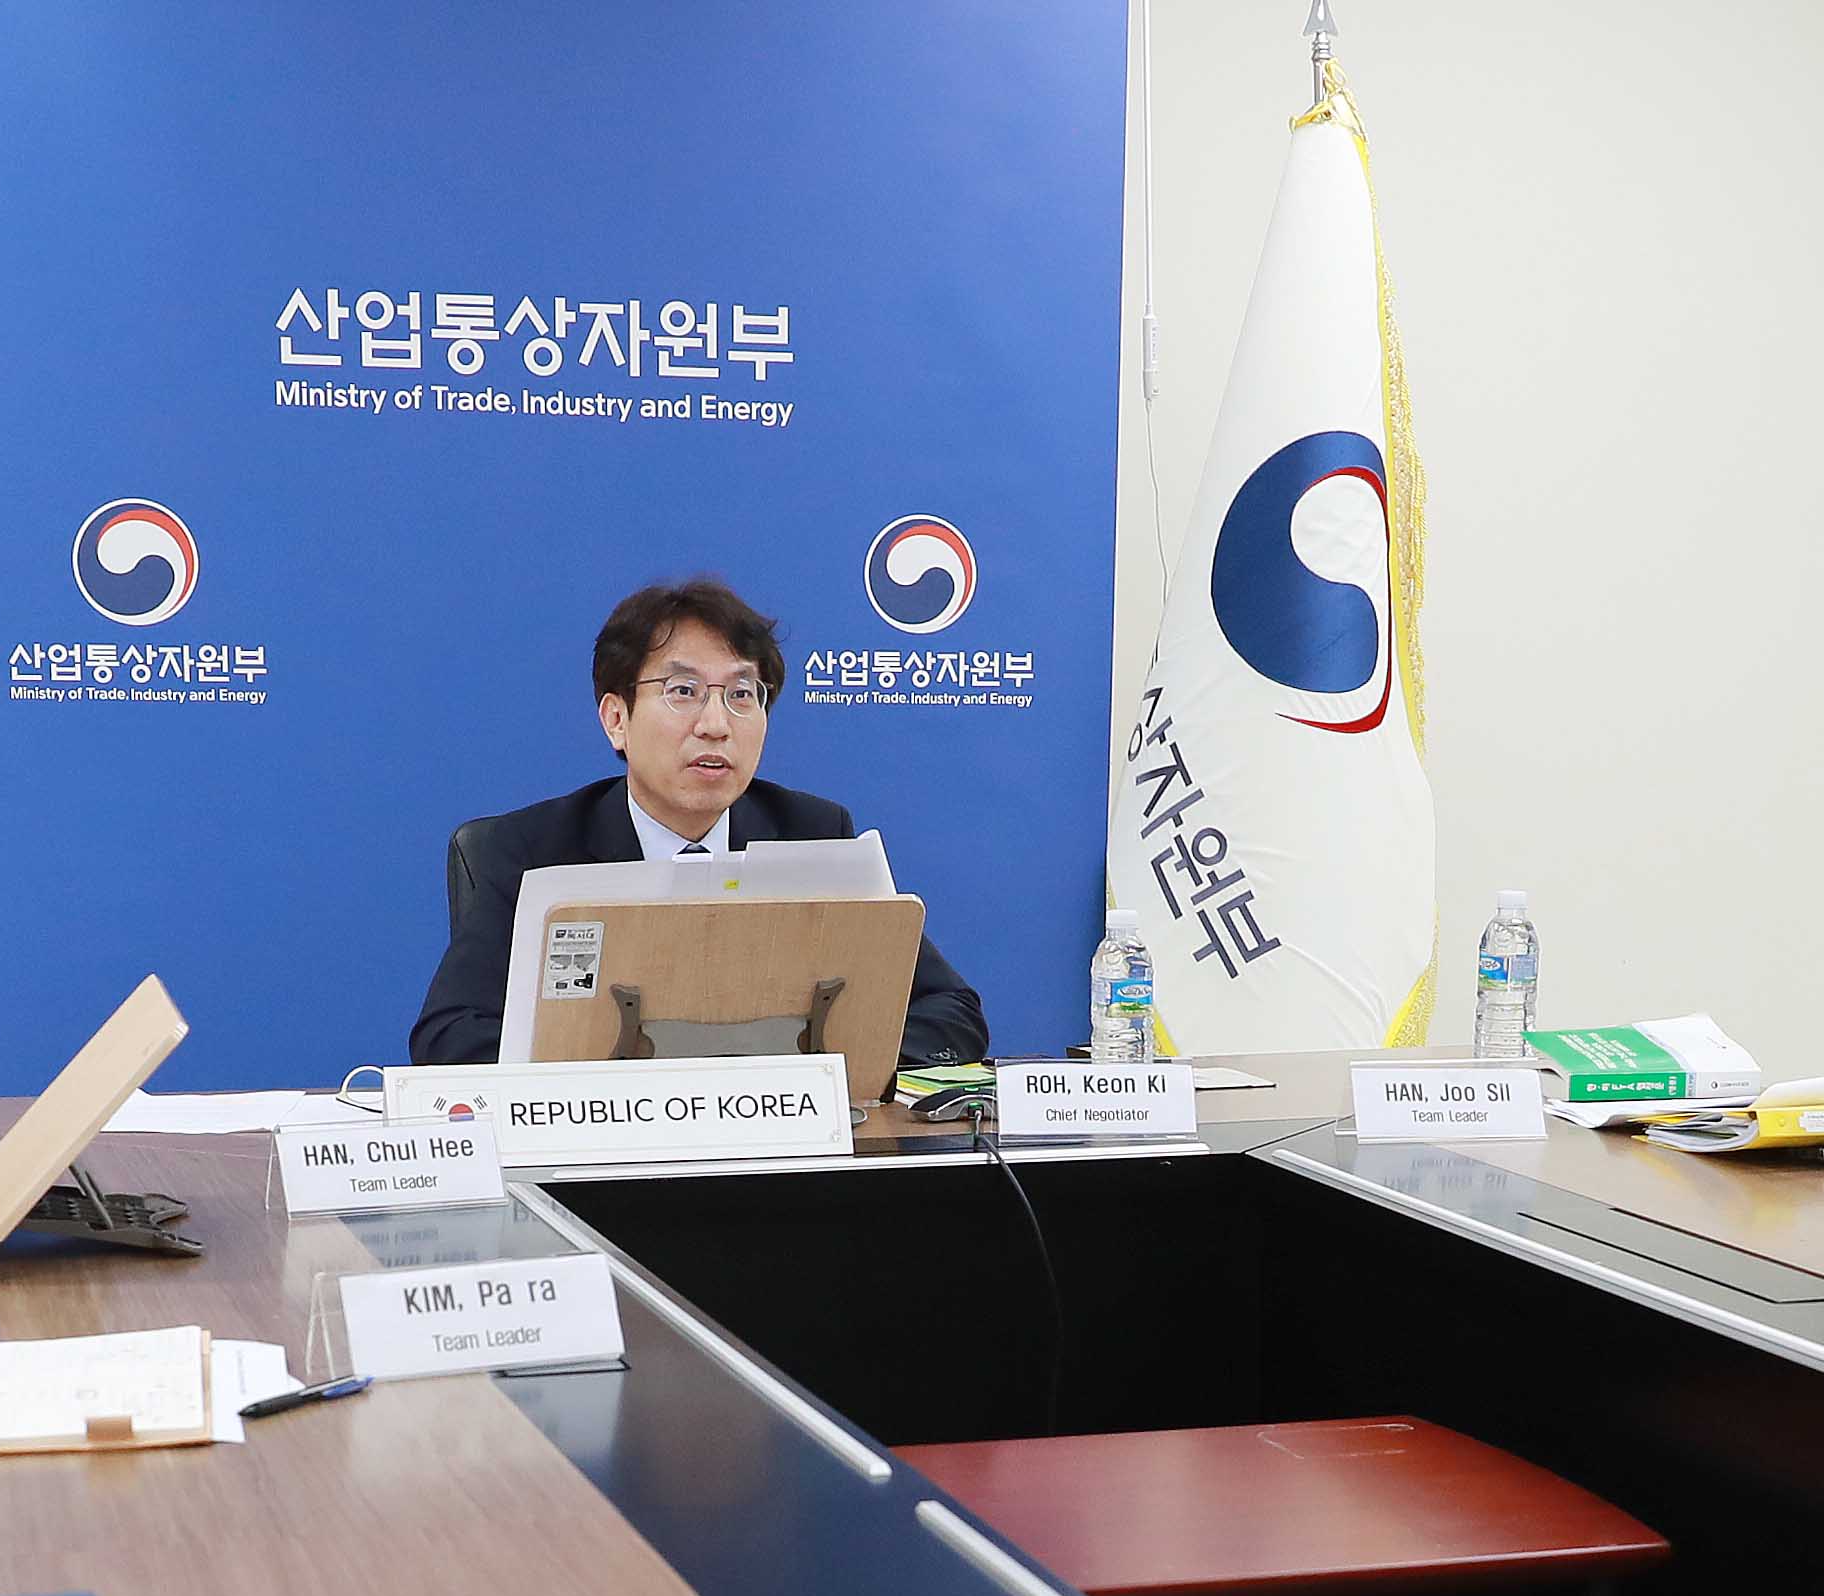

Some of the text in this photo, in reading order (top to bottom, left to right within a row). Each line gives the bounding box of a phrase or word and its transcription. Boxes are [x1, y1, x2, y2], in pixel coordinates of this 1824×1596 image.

[276, 287, 794, 381] 산업통상자원부
[275, 381, 794, 427] Ministry of Trade, Industry and Energy
[9, 643, 268, 684] 산업통상자원부
[804, 650, 1034, 689] 산업통상자원부
[10, 686, 65, 703] Ministry
[67, 687, 83, 700] of
[130, 688, 187, 704] Industry
[189, 688, 216, 701] and
[219, 688, 267, 705] Energy
[804, 690, 854, 707] Ministry
[855, 691, 869, 704] of
[910, 692, 961, 707] Industry
[962, 692, 987, 705] and
[989, 692, 1033, 708] Energy
[1128, 686, 1282, 979] 상자원부
[1026, 1075, 1072, 1097] ROH,
[1083, 1075, 1136, 1094] Keon
[1385, 1083, 1429, 1104] HAN,
[1440, 1083, 1476, 1102] Joo
[509, 1092, 819, 1126] REPUBLIC OF KOREA
[1045, 1109, 1149, 1122] Chief Negotiator
[1411, 1110, 1488, 1122] Team Leader
[303, 1138, 474, 1167] HAN, Chul Hee
[350, 1174, 439, 1193] Team Leader
[403, 1279, 556, 1314] KIM, Pa ra
[432, 1327, 542, 1352] Team Leader
